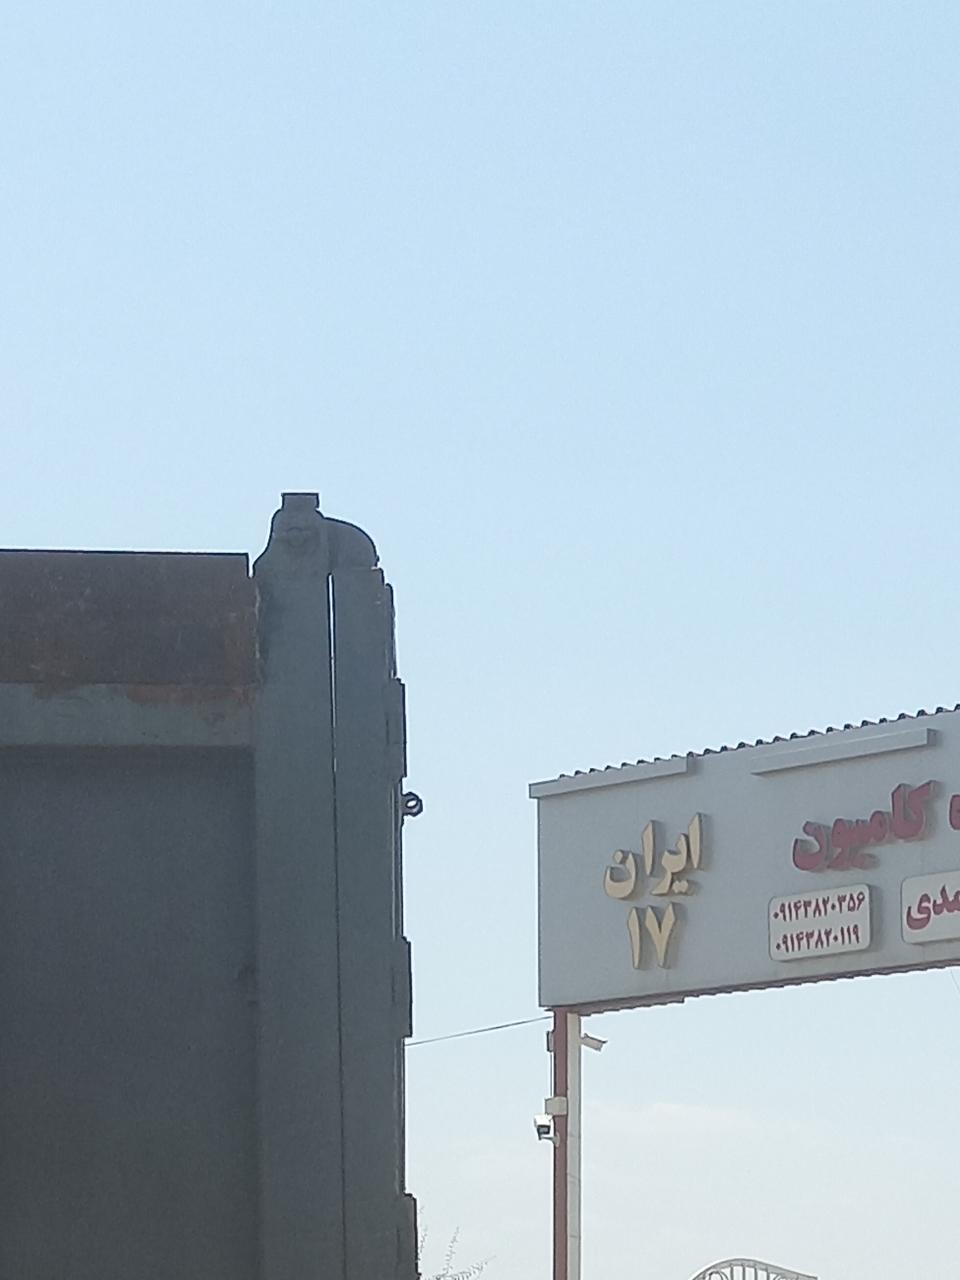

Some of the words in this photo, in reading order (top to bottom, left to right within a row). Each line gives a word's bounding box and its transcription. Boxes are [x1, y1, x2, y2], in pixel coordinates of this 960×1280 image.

[604, 812, 703, 899] ایران
[793, 781, 938, 871] کامیون
[627, 902, 676, 969] ۱۷
